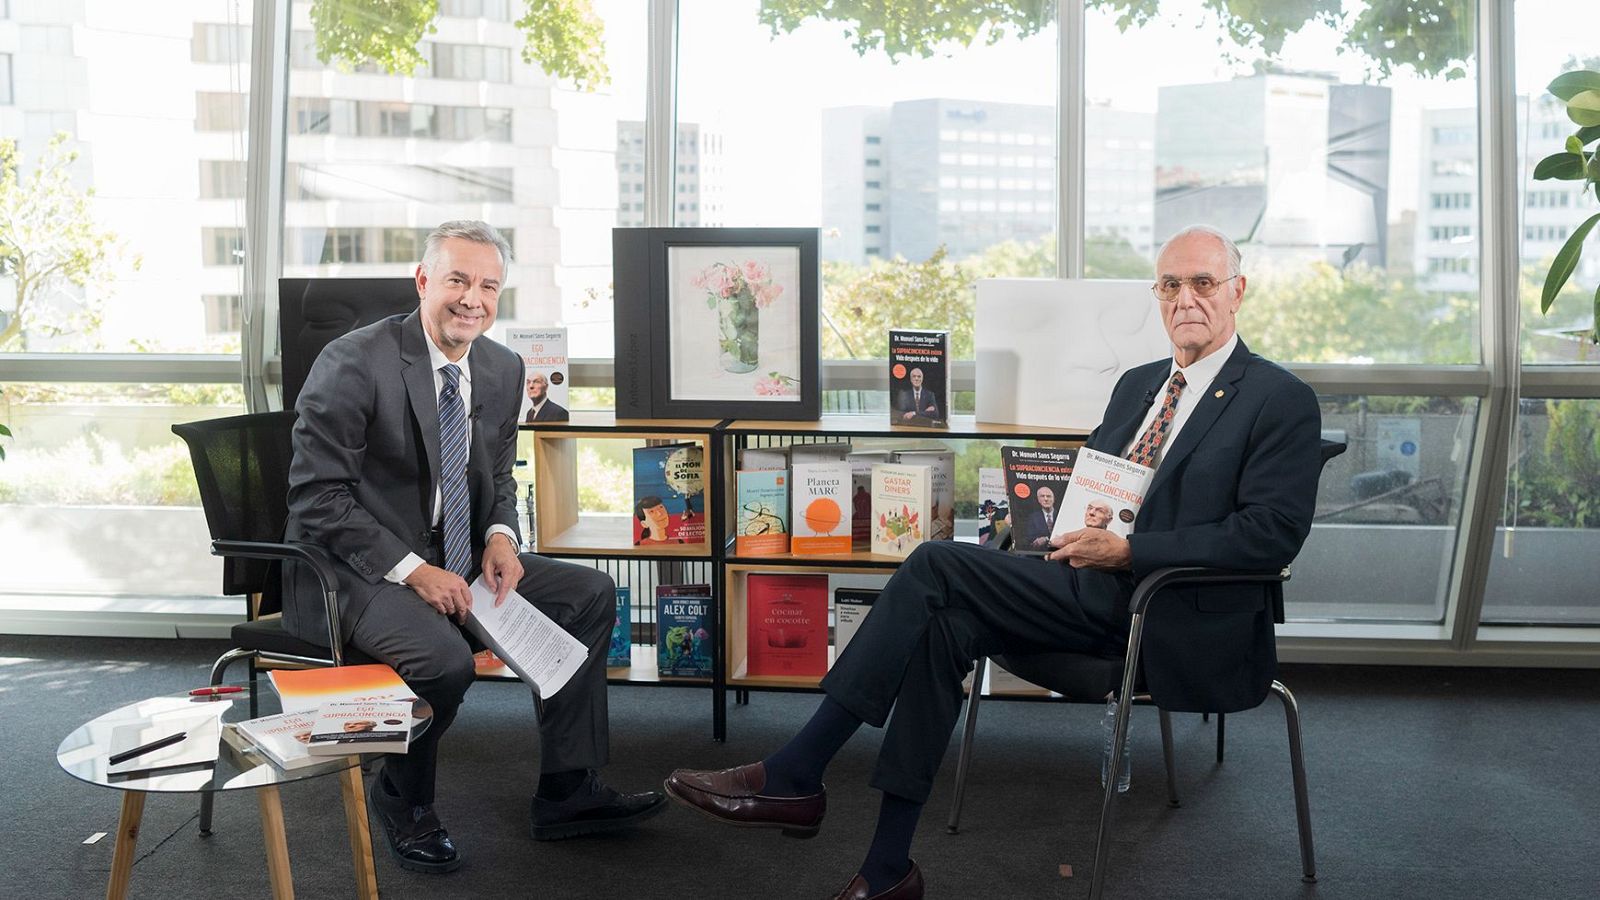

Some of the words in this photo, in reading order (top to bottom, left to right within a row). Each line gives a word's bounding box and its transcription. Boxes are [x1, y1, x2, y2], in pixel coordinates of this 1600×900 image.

[532, 344, 543, 352] EGO
[1019, 450, 1037, 459] Manuel
[1051, 453, 1070, 461] Segarra
[1016, 465, 1059, 473] SUPRACONCIENCIA
[1095, 455, 1113, 465] Manuel
[1113, 460, 1125, 469] Sans
[1126, 464, 1146, 476] Segarra
[1104, 470, 1120, 482] EGO
[884, 477, 911, 486] GASTAR
[885, 485, 910, 495] DINERS
[1074, 475, 1143, 505] SUPRACONCIENCIA
[616, 596, 625, 606] LT
[664, 605, 685, 615] ALEX
[688, 605, 707, 615] COLT
